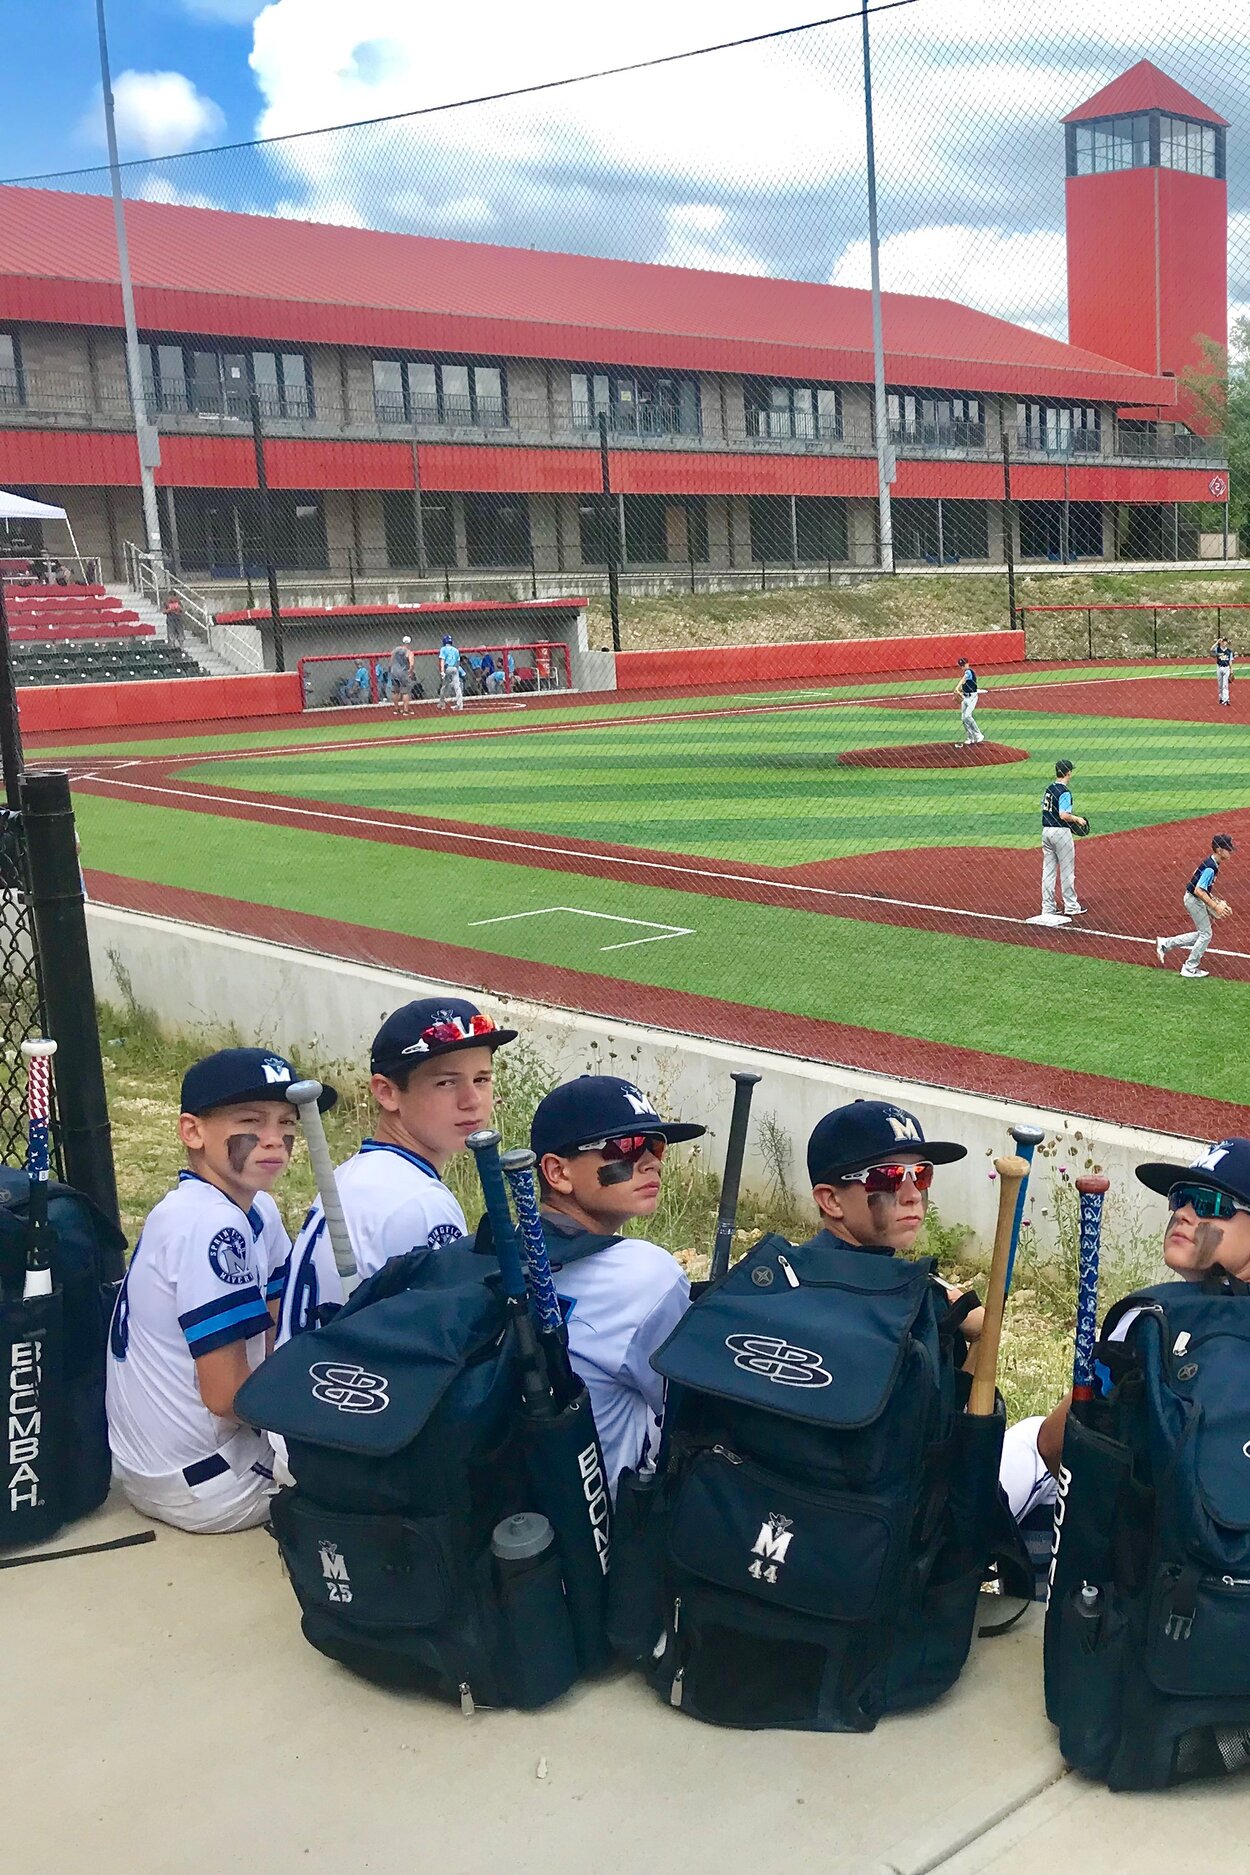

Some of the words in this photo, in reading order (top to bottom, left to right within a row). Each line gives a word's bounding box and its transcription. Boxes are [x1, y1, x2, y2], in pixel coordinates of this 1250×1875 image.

[1214, 482, 1221, 491] 2
[261, 1064, 291, 1084] M
[622, 1093, 657, 1116] M
[886, 1116, 922, 1142] M
[1189, 1148, 1231, 1172] M
[750, 1522, 794, 1564] M
[318, 1549, 350, 1581] M
[747, 1559, 778, 1584] 44
[326, 1582, 353, 1603] 25
